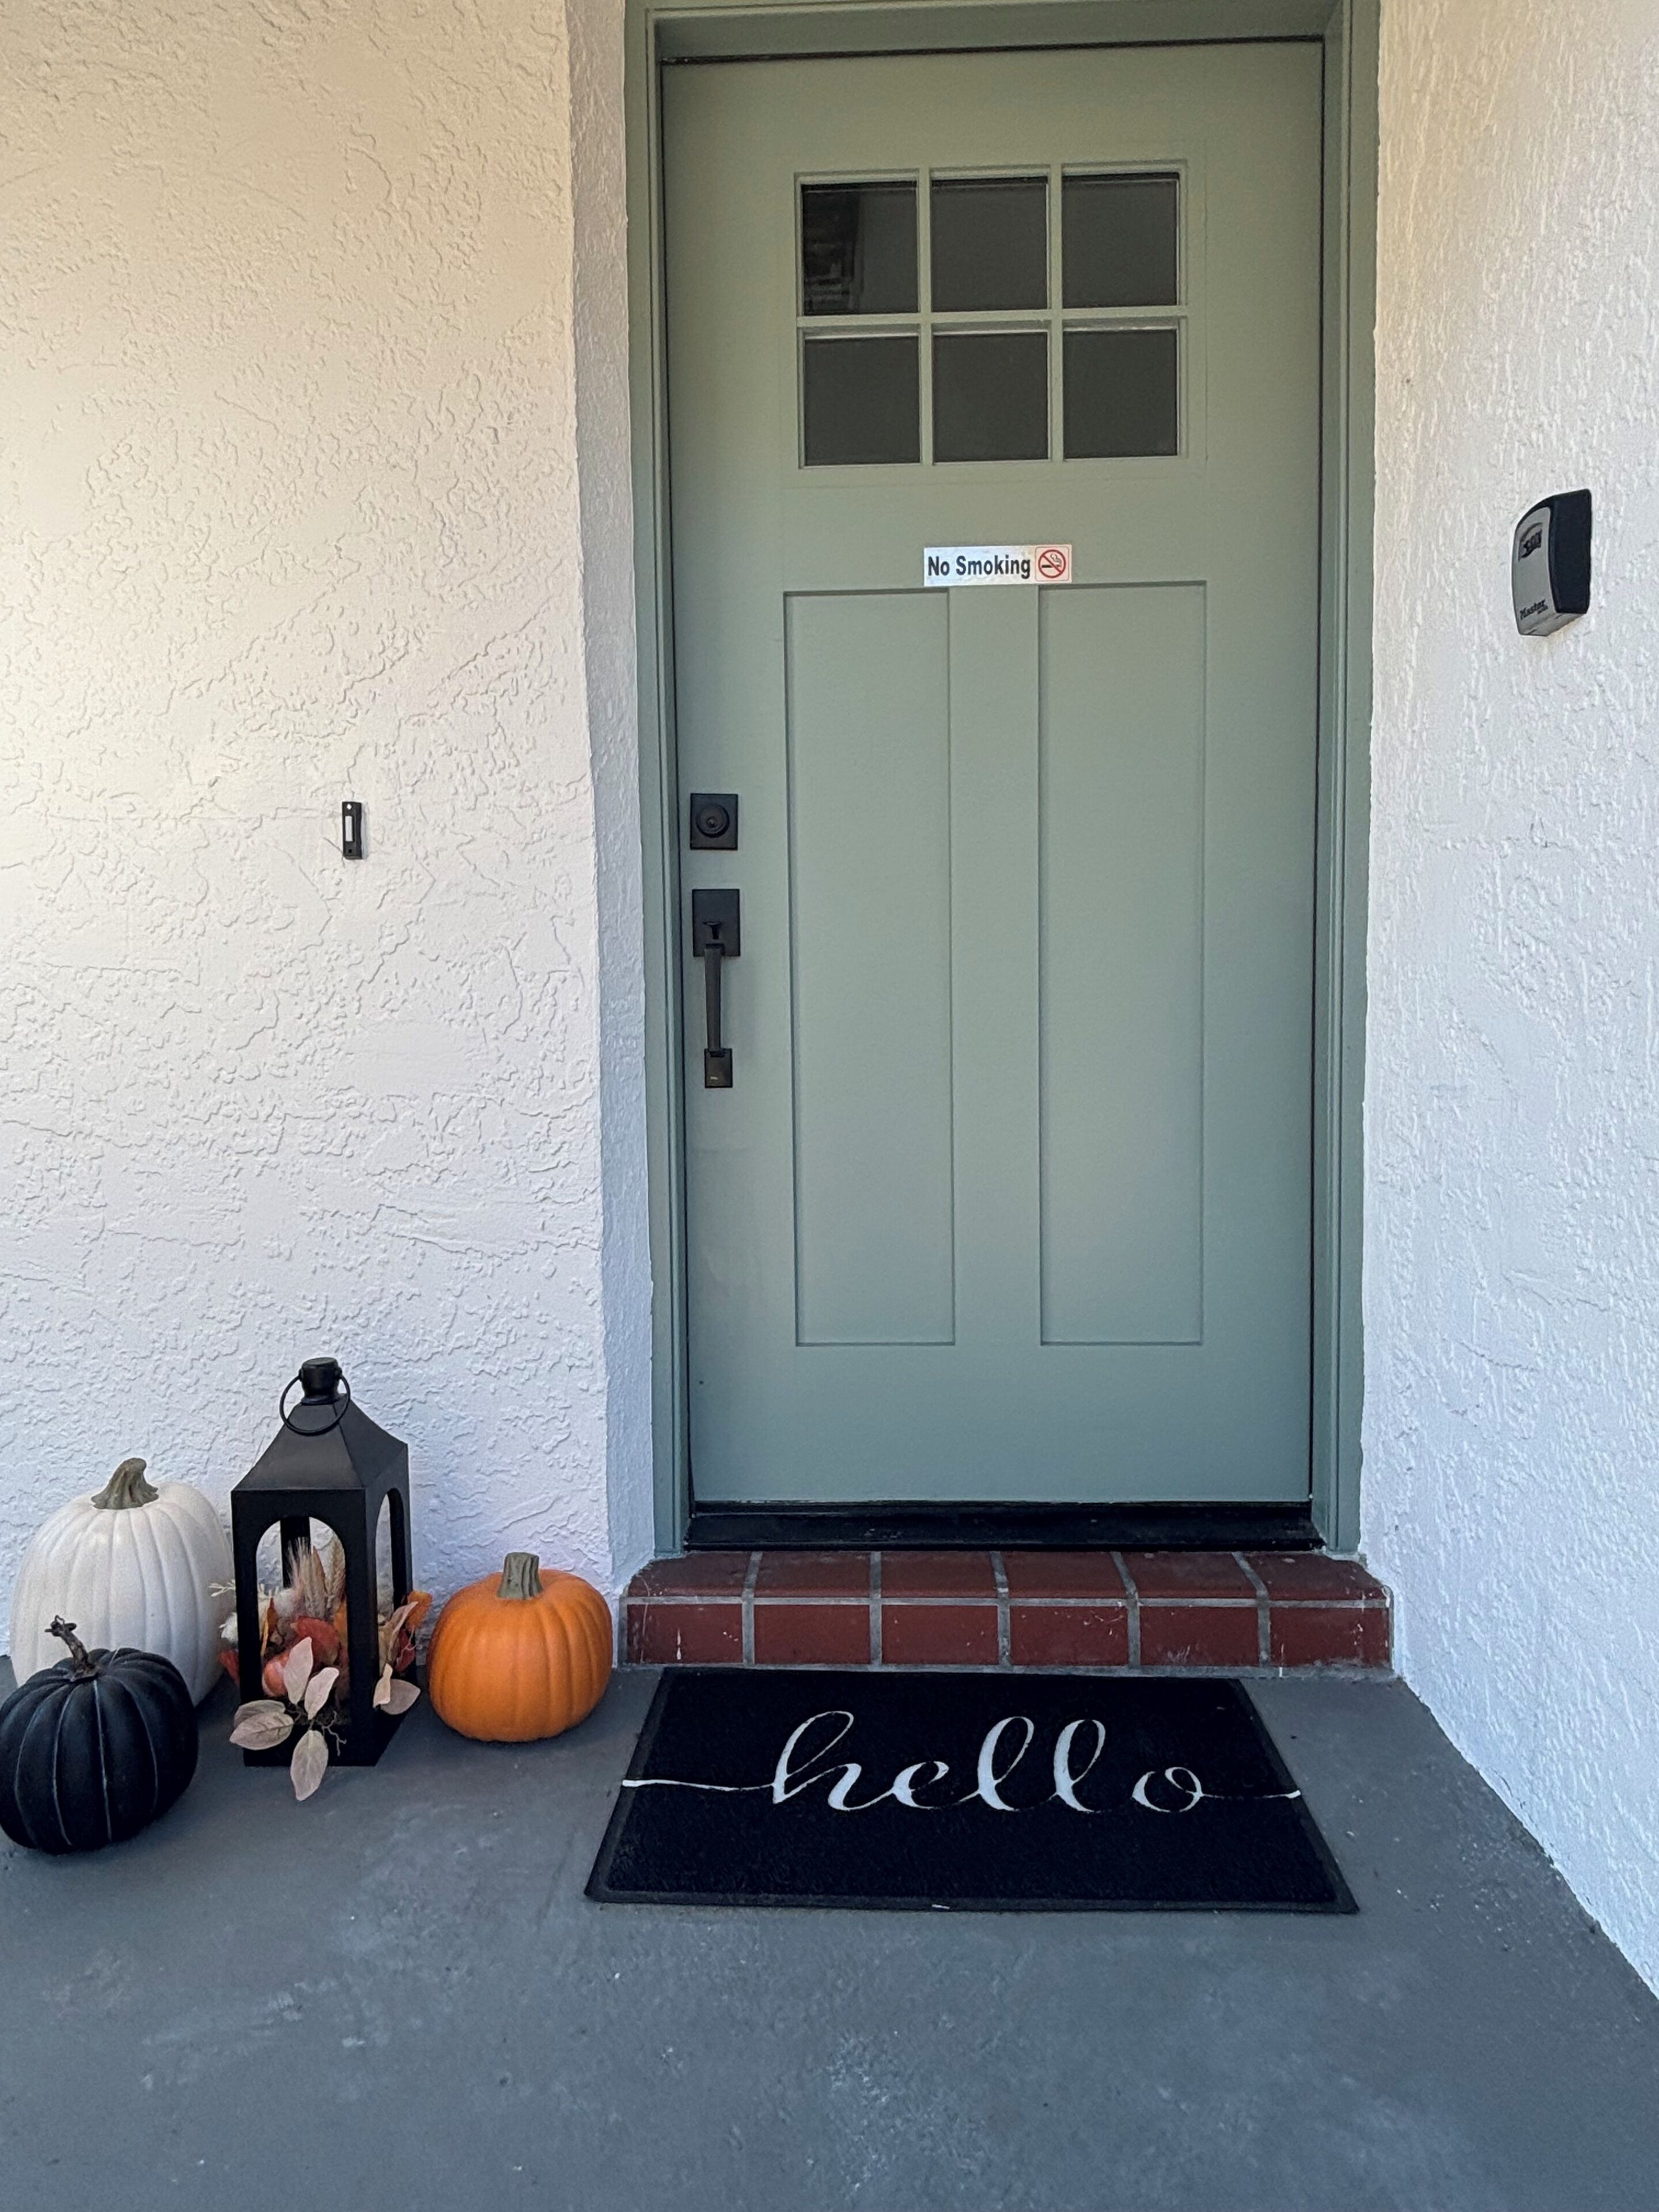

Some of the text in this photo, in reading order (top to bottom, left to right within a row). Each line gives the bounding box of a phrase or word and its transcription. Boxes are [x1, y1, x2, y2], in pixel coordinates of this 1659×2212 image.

[928, 555, 1031, 579] No Smoking
[770, 1710, 1210, 1813] hello
